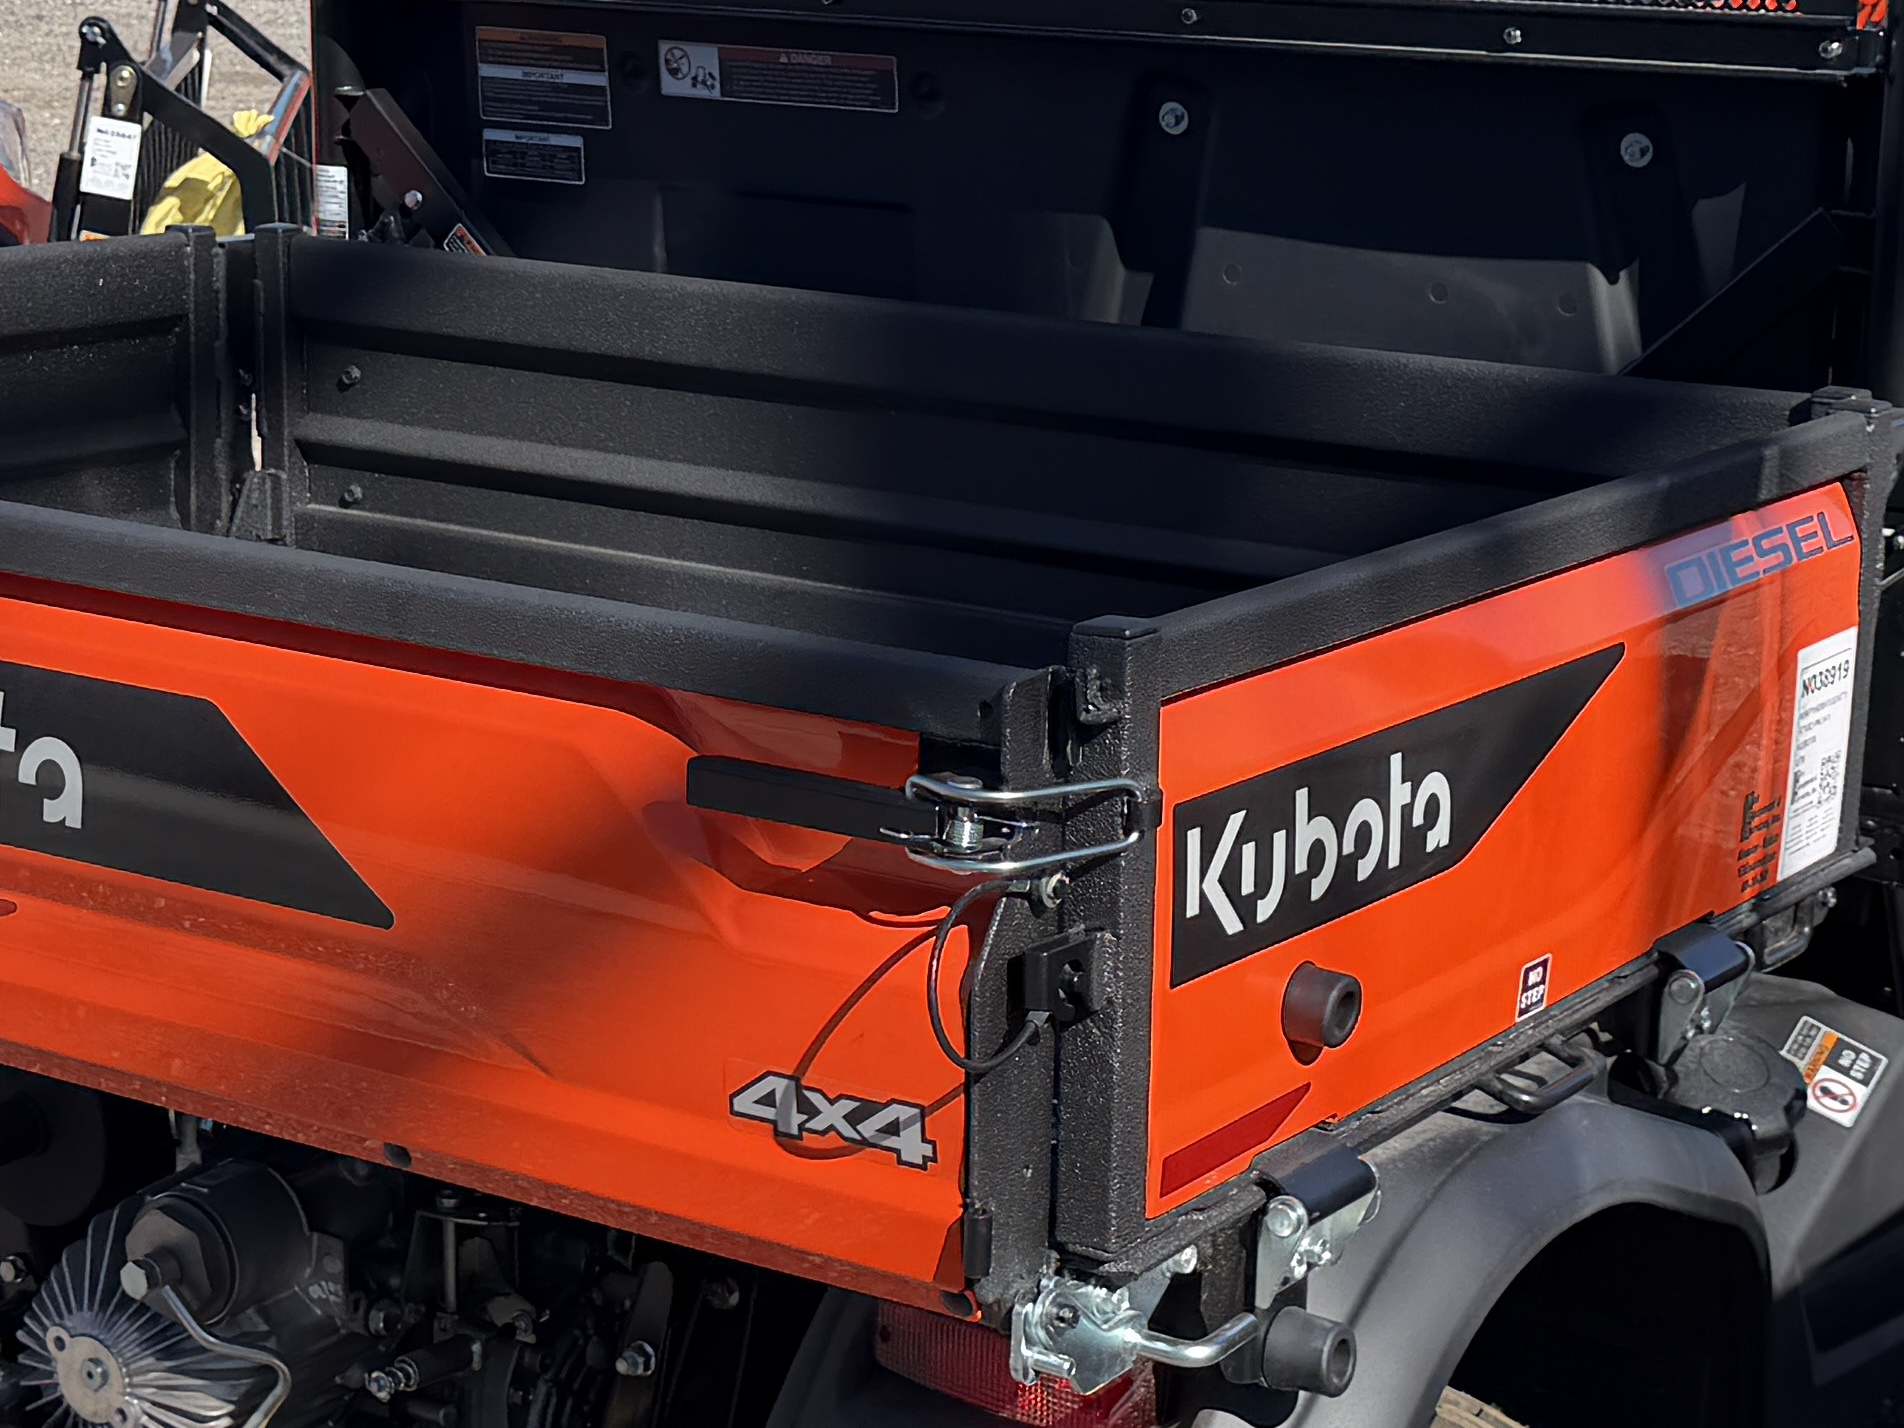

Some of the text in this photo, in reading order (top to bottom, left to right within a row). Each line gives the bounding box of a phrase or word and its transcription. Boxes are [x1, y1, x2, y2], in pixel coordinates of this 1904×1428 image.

[1664, 510, 1854, 610] DIESEL
[1185, 751, 1452, 936] Kubota
[1528, 966, 1544, 986] NO
[1520, 984, 1545, 1009] STEP
[1837, 1049, 1856, 1068] NO
[1849, 1051, 1873, 1080] STEP
[730, 1070, 937, 1170] 4x4
